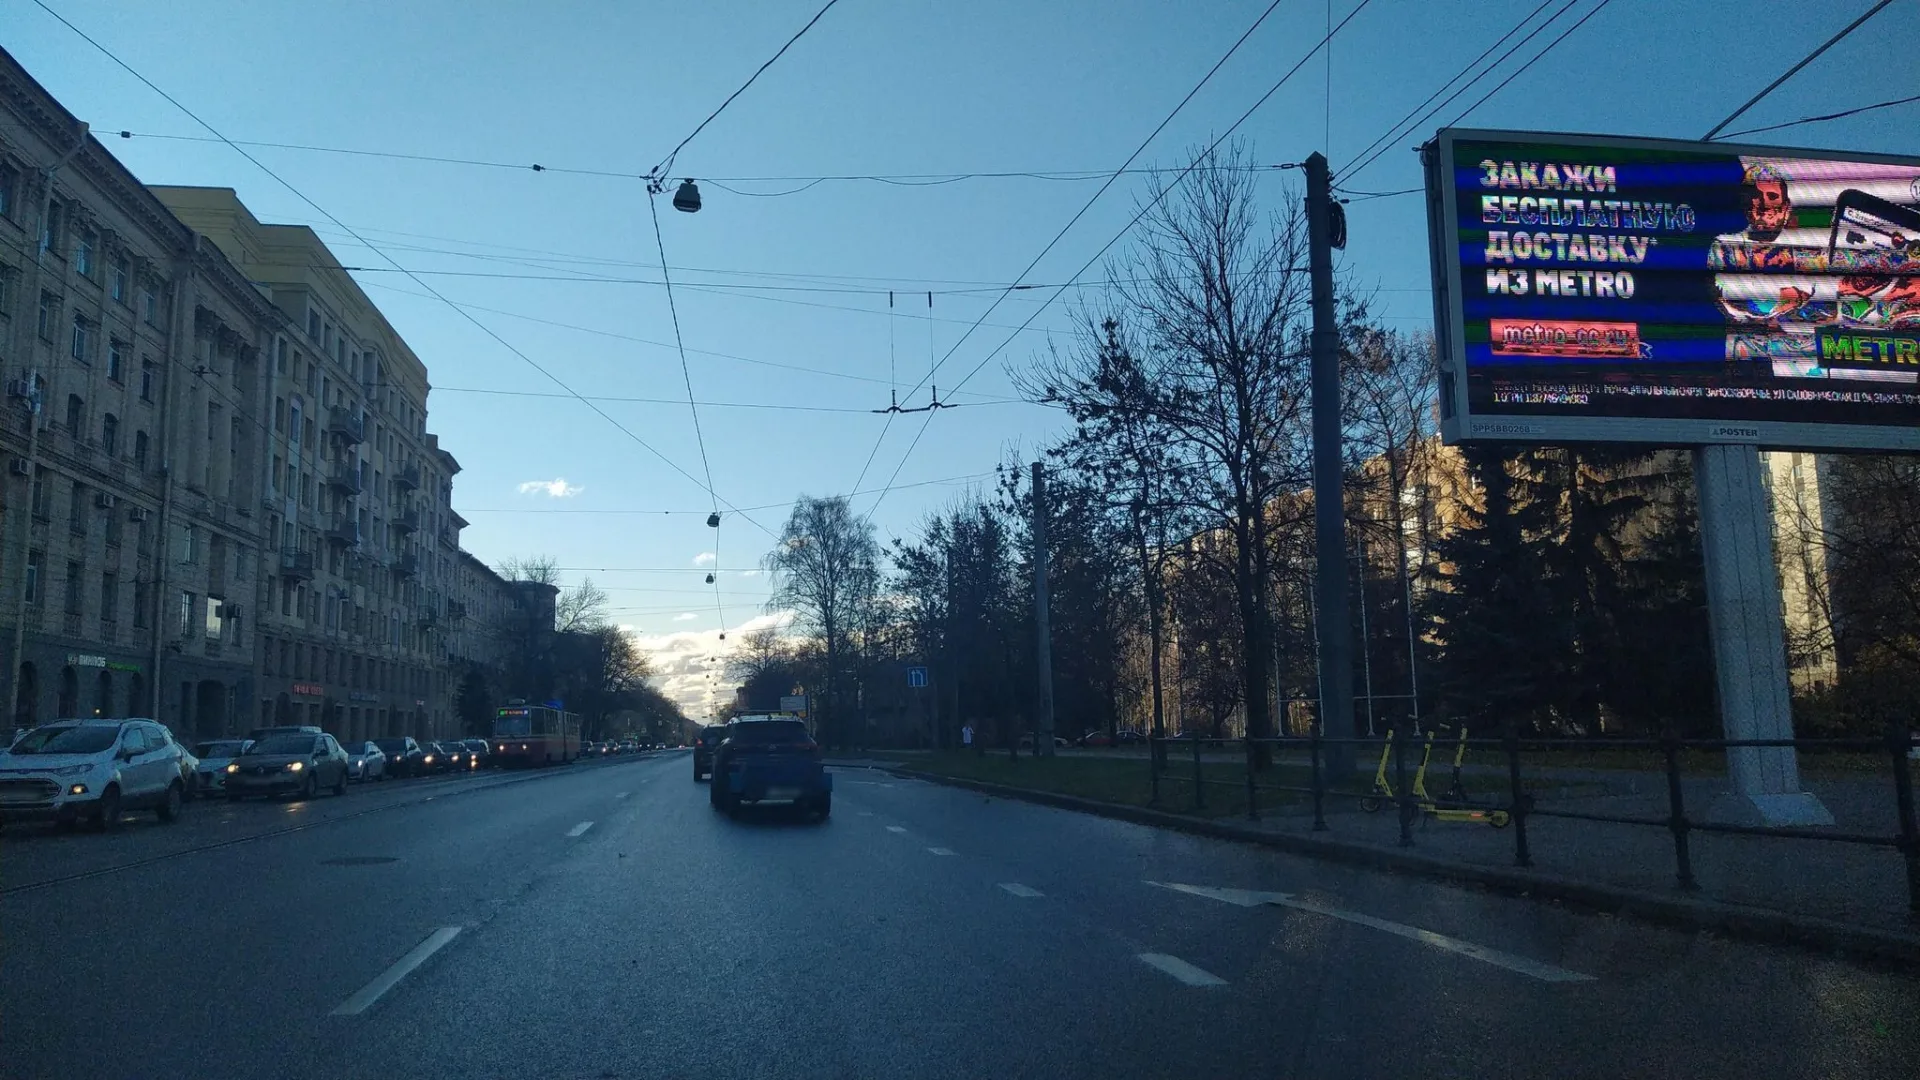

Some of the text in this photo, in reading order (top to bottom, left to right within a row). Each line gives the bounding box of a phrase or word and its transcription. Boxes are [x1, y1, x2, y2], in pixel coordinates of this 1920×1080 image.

[1479, 159, 1616, 193] ЗАКАЖИ
[1482, 195, 1696, 232] БЕСПЛАТНУЮ
[1486, 268, 1635, 299] ИЗ METRO
[1821, 334, 1920, 365] METR
[1719, 427, 1758, 437] POSTER
